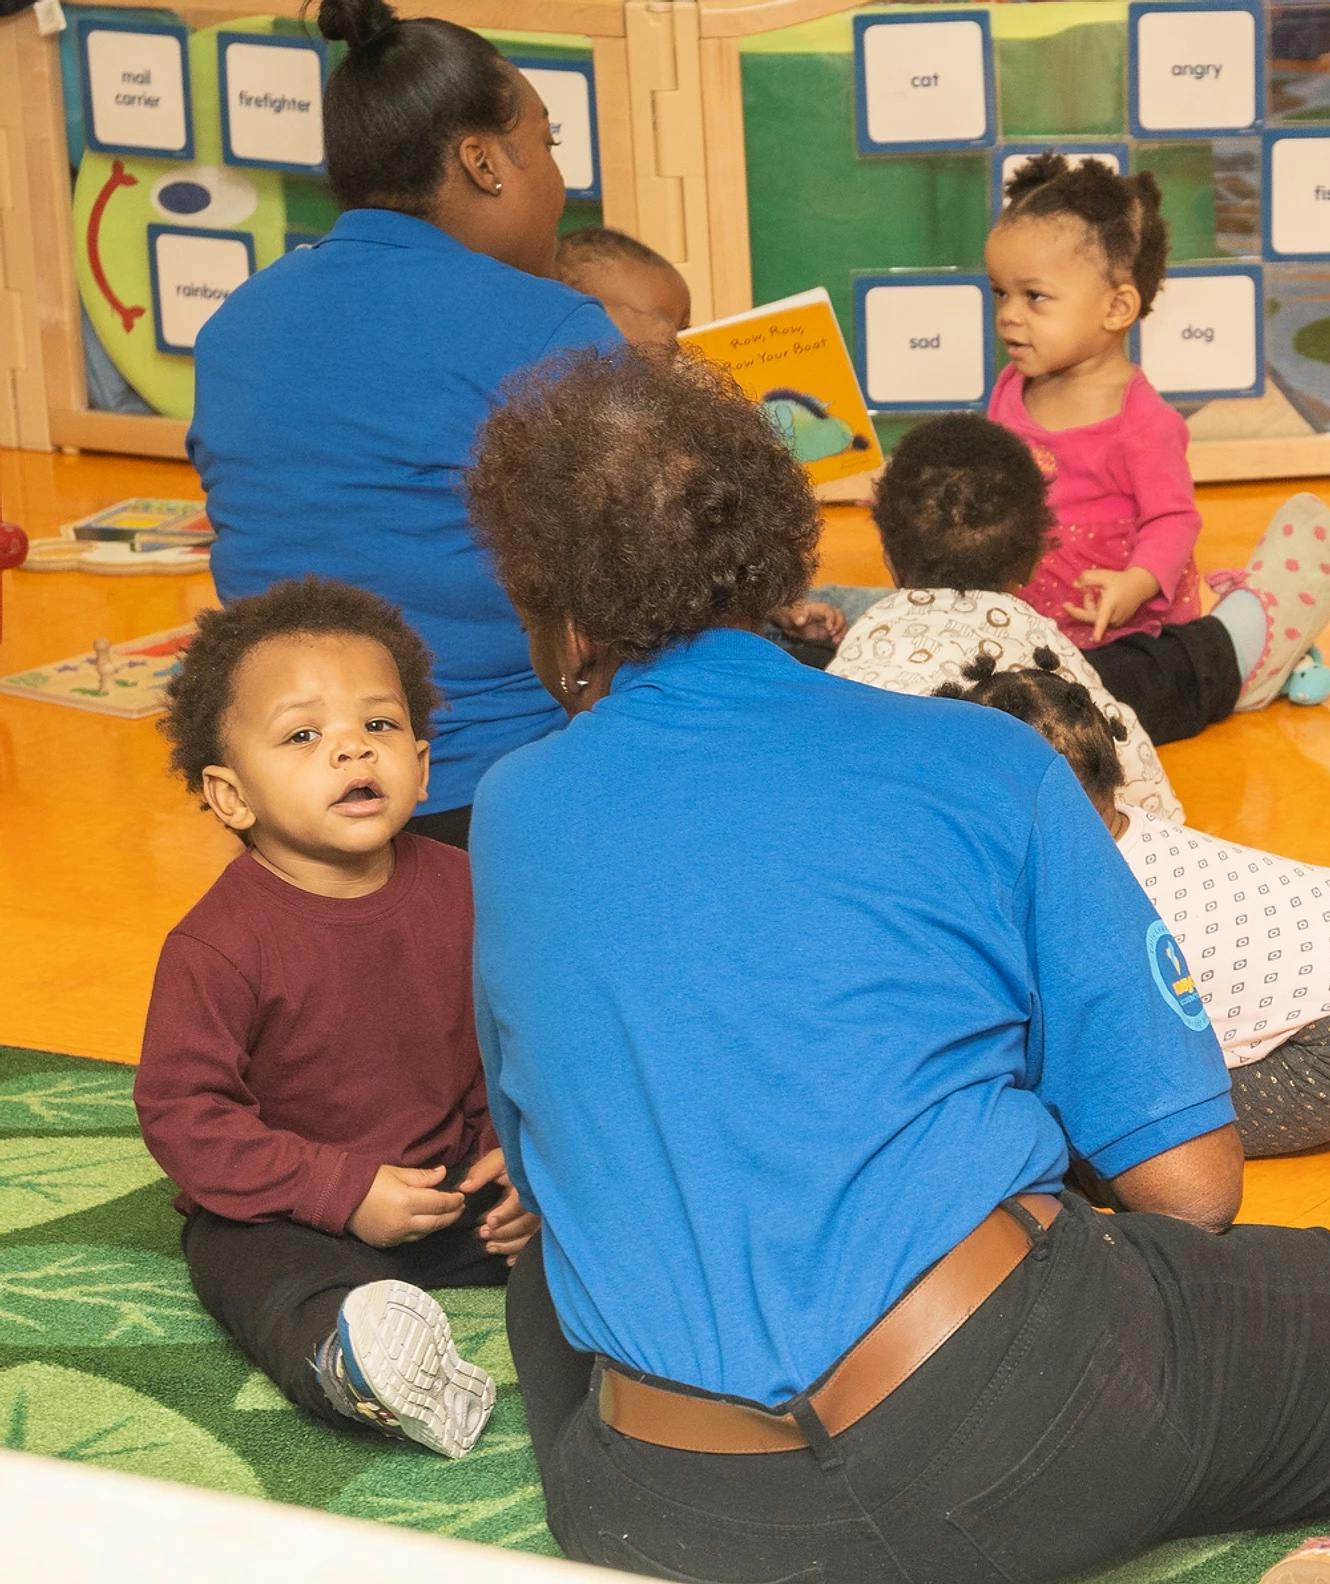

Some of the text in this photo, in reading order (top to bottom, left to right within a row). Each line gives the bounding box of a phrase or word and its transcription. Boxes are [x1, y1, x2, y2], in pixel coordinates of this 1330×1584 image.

[121, 69, 152, 86] mail
[910, 72, 940, 88] cat
[1171, 63, 1223, 80] angry
[114, 92, 161, 109] carrier
[238, 90, 312, 115] firefighter
[730, 325, 804, 349] Row, Row,
[909, 333, 941, 350] sad
[1181, 325, 1215, 344] dog
[759, 351, 788, 363] Your
[793, 338, 827, 354] Boat
